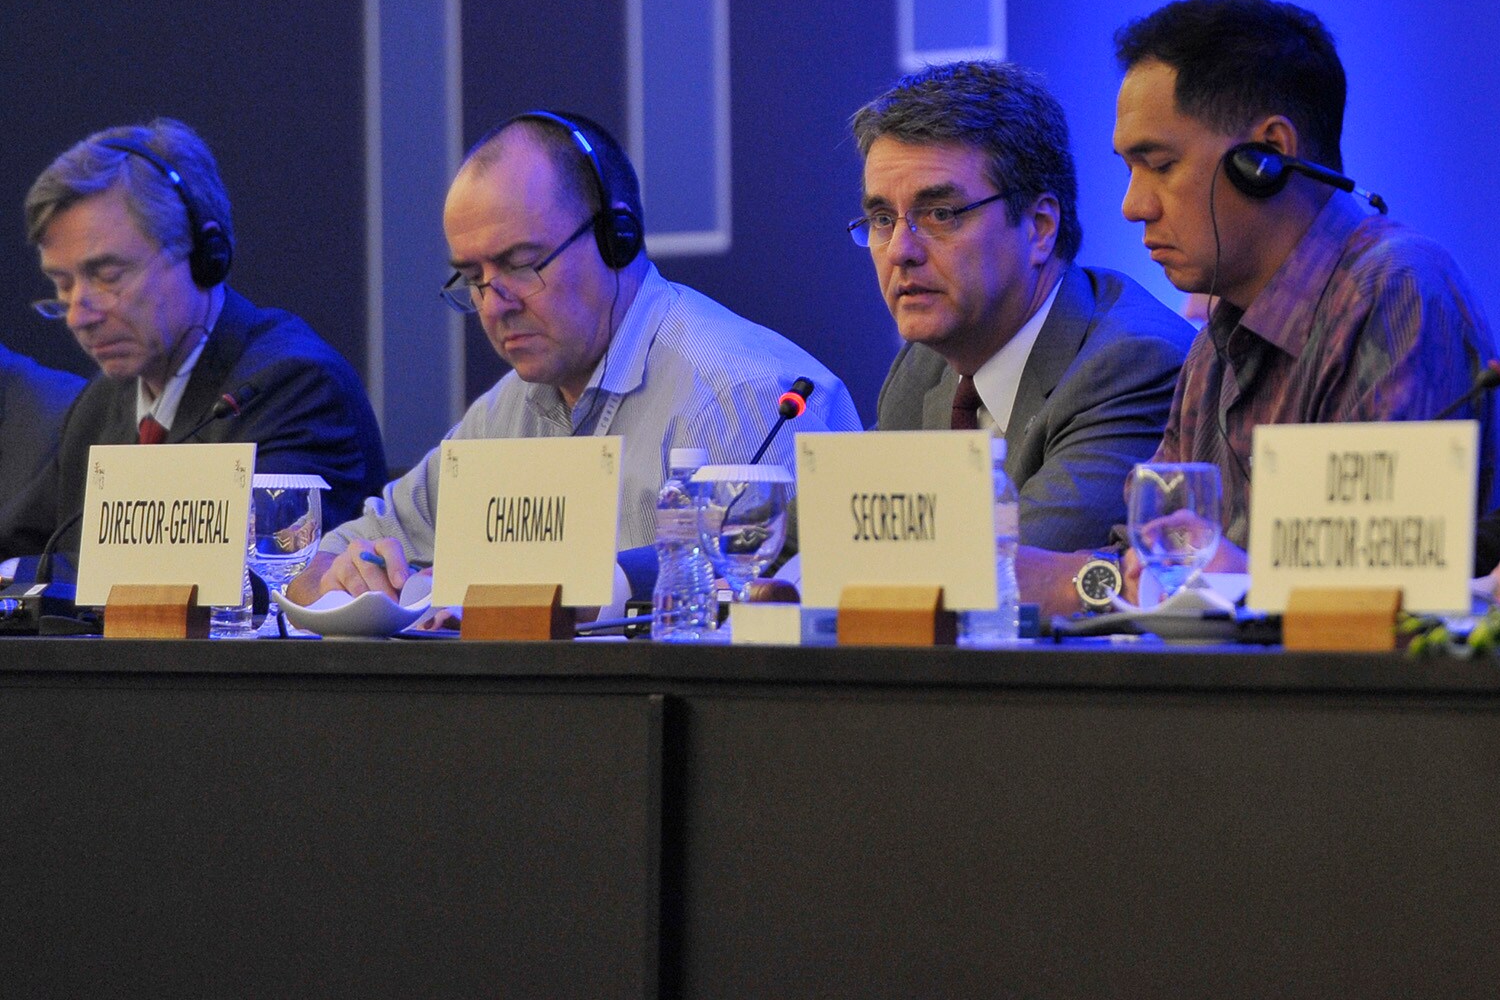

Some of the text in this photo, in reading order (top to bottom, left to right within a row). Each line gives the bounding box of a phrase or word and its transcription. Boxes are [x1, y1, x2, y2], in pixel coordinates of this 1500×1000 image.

[1328, 451, 1395, 501] DEPUTY
[98, 500, 229, 545] DIRECTOR-GENERAL
[486, 495, 566, 542] CHAIRMAN
[852, 492, 936, 541] SECRETARY
[1273, 517, 1447, 568] DIRECTOR-GENERAL
